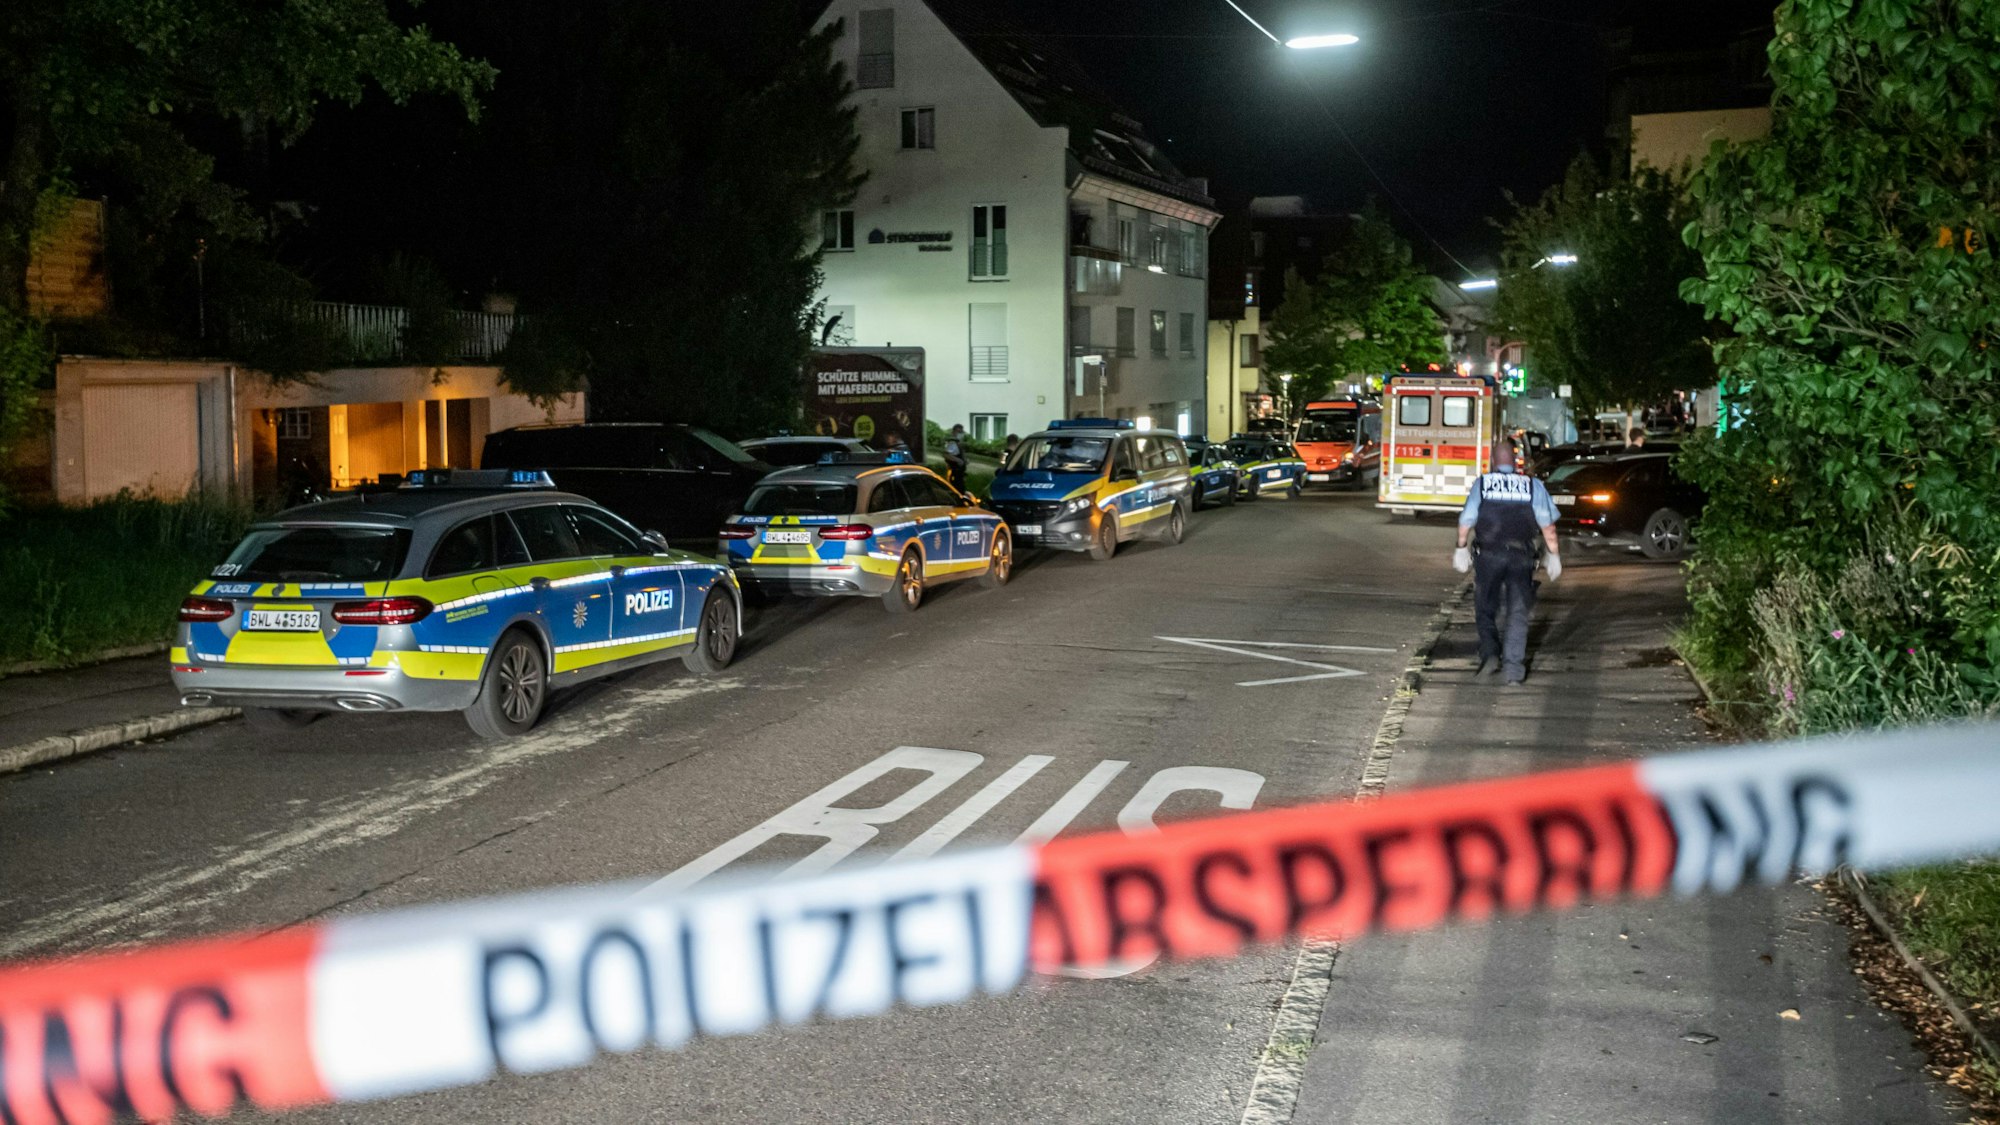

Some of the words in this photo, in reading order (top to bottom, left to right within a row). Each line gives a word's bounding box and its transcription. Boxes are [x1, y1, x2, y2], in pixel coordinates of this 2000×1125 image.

[817, 369, 859, 382] SCHÜTZE
[861, 371, 904, 381] HUMMEL
[818, 384, 836, 395] MIT
[837, 383, 908, 394] HAFERFLOCKEN
[1402, 446, 1422, 456] 112
[1482, 474, 1530, 494] POLIZEI
[957, 531, 980, 545] POLIZEI
[214, 584, 252, 593] POLIZEI
[625, 588, 673, 616] POLIZEI
[250, 613, 271, 627] BWL
[290, 614, 318, 627] 5182
[0, 986, 248, 1125] NG
